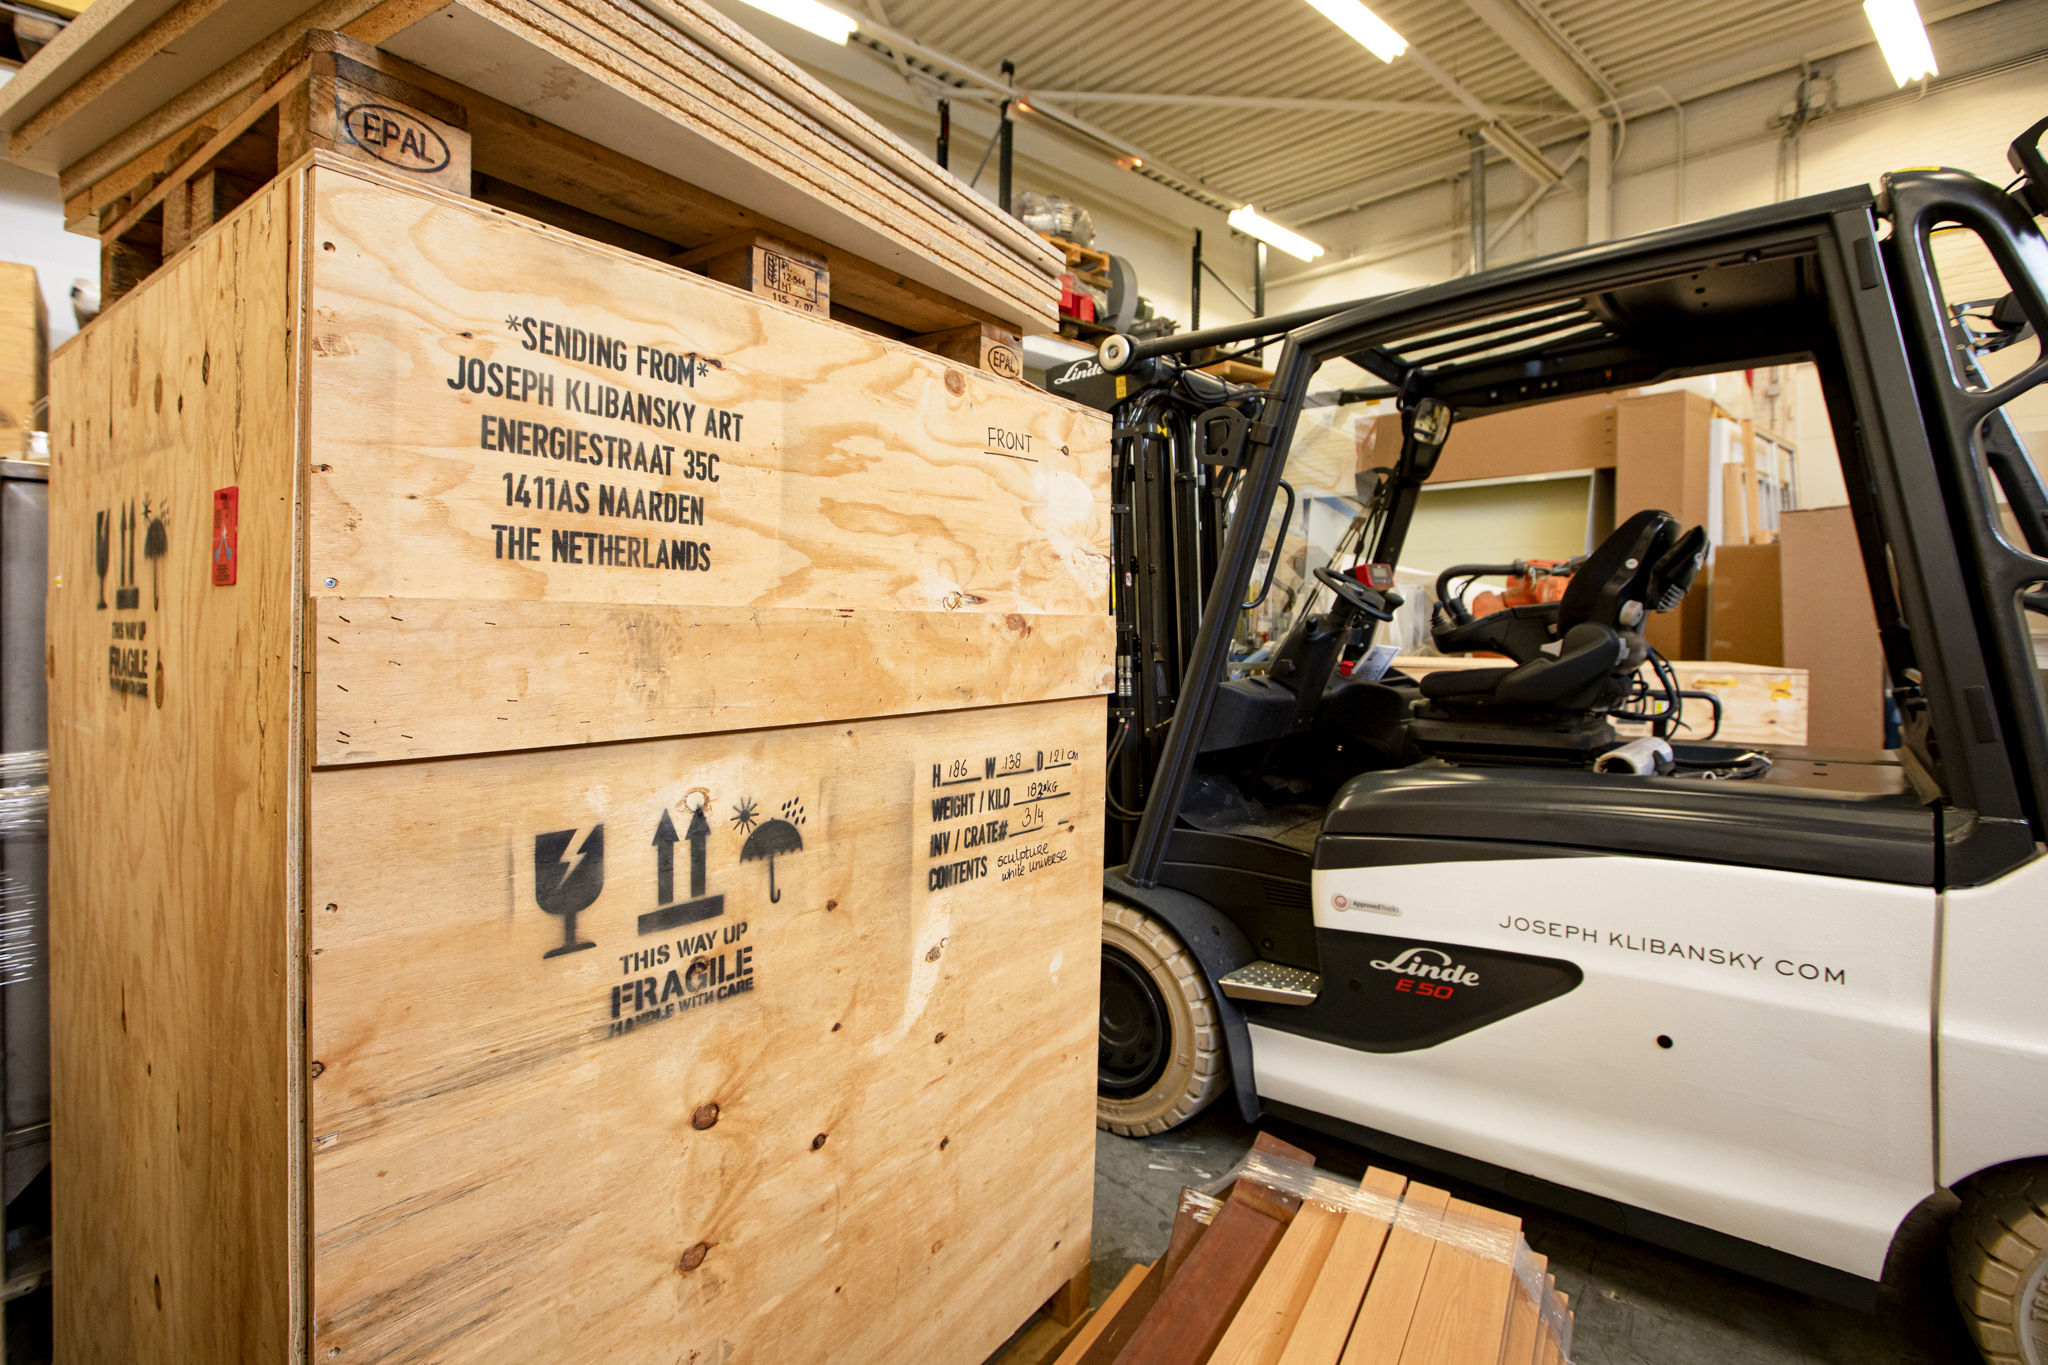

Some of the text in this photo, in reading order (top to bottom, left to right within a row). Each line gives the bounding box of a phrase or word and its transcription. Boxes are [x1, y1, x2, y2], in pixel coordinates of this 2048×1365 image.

[363, 111, 435, 164] EPAL
[993, 350, 1016, 373] EPAL
[1053, 359, 1105, 385] Linde
[447, 355, 744, 442] JOSEPH KLIBANSKY ART
[481, 414, 720, 483] ENERGIESTRAAT 35C
[987, 426, 1033, 453] FRONT
[502, 472, 704, 526] 1411AS NAARDEN
[491, 524, 711, 572] THE NETHERLANDS
[138, 621, 147, 641] UP
[109, 645, 148, 680] FRAGILE
[932, 764, 942, 788] H
[948, 759, 968, 778] 186
[985, 757, 996, 779] W
[1003, 752, 1022, 770] 138
[1037, 750, 1044, 771] D
[932, 793, 975, 822] WEIGHT
[988, 787, 1011, 812] KILO
[930, 831, 951, 857] INV
[964, 820, 1008, 849] CRATE#
[929, 856, 988, 891] CONTENTS
[1001, 850, 1068, 882] white universe
[619, 921, 748, 975] THIS WAY UP
[1369, 947, 1480, 986] Linde
[1499, 916, 1845, 985] JOSEPH KLIBANSKY COM
[611, 946, 754, 1018] FRAGILE
[1395, 978, 1454, 1000] E 50
[609, 977, 754, 1038] HANDLE WITH CARE
